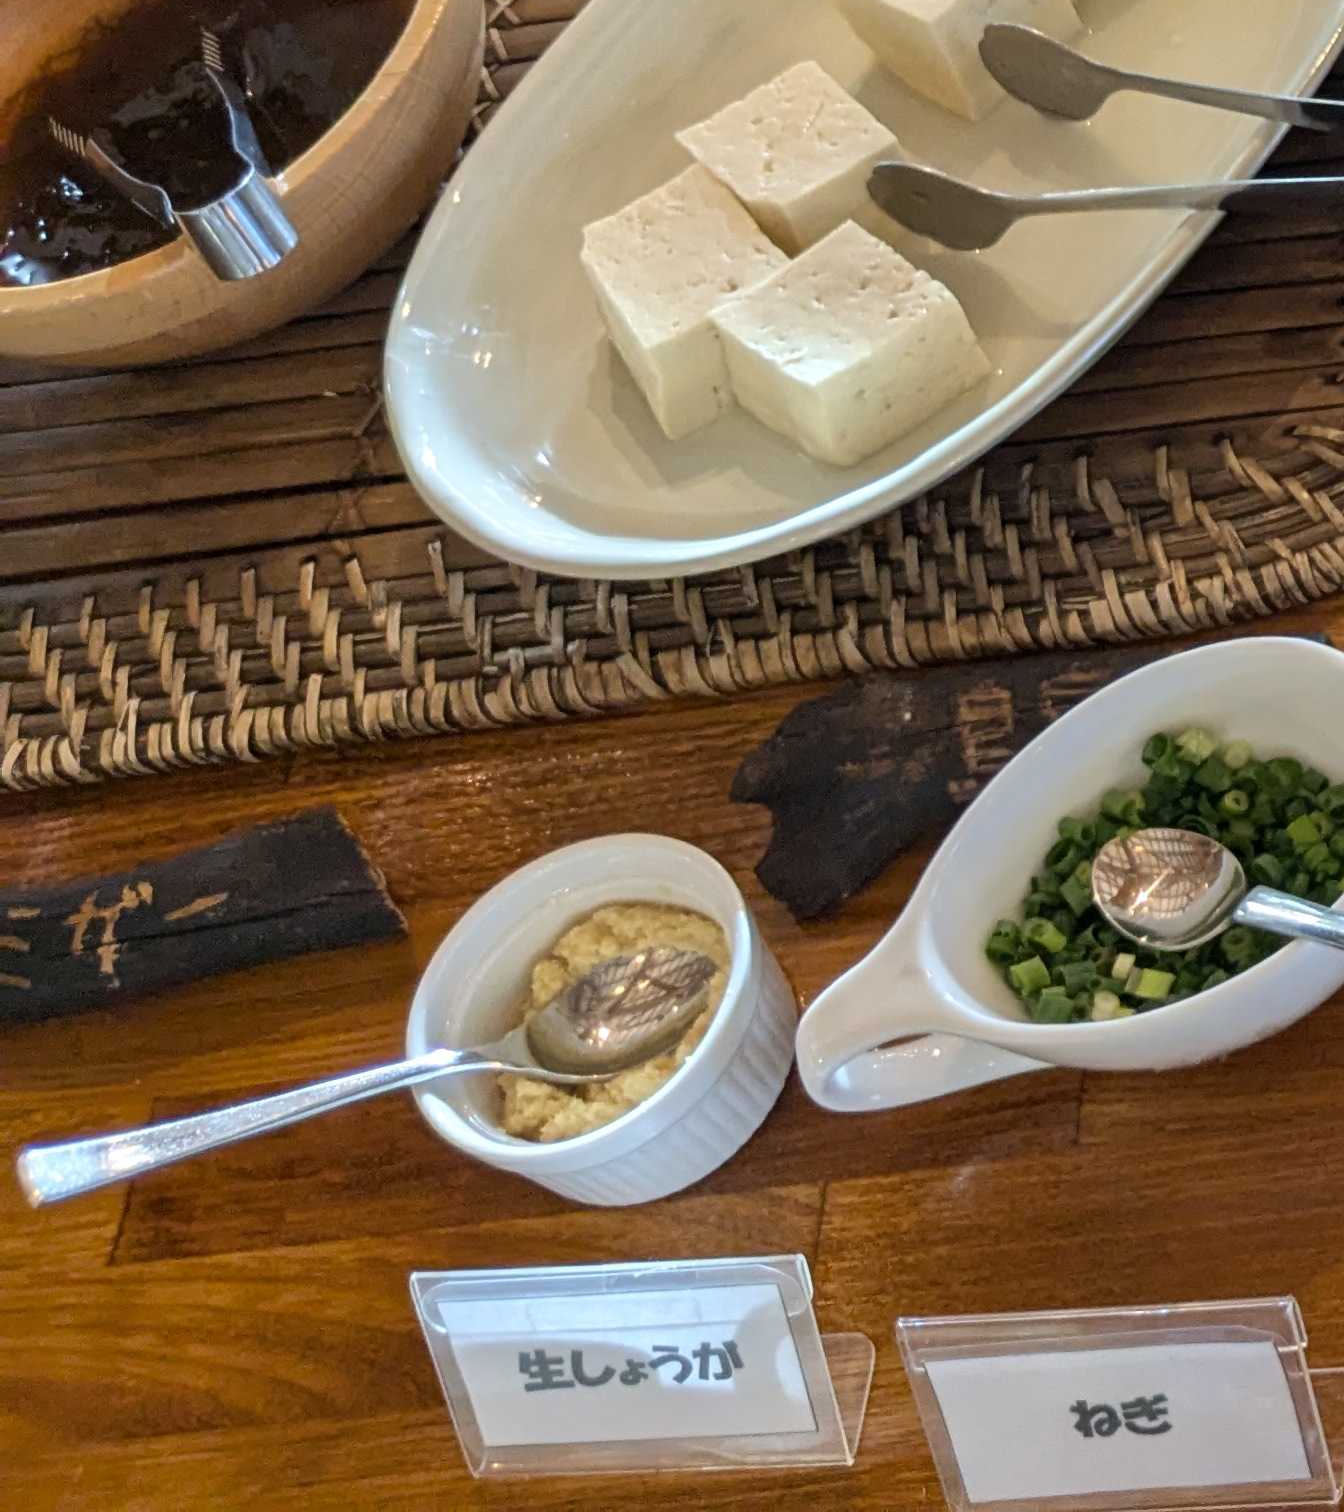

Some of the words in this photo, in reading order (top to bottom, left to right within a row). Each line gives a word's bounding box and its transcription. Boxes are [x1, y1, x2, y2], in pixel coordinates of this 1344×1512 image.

[518, 1343, 745, 1392] 生しょうが
[1070, 1393, 1174, 1438] ねぎ
